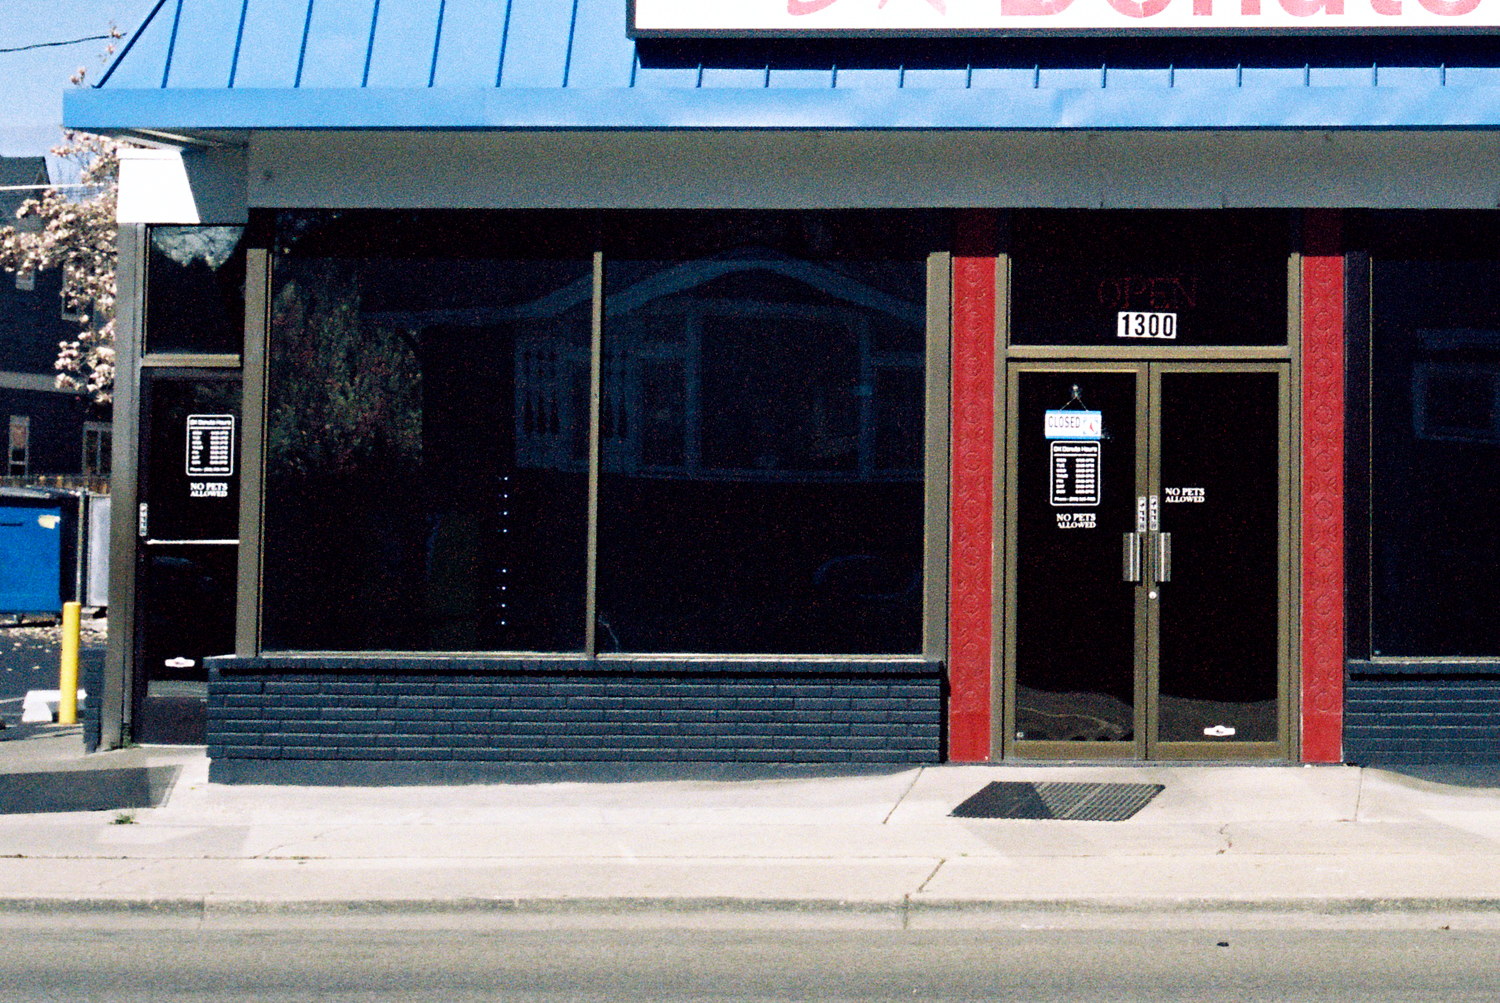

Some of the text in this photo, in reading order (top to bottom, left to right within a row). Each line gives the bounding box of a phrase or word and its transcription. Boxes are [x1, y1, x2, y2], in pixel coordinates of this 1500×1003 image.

[1099, 277, 1197, 308] OPEN
[1122, 314, 1174, 336] 1300
[1048, 416, 1081, 428] CLOSED
[190, 482, 229, 491] NO PETS
[190, 490, 228, 498] ALLOWED
[1165, 487, 1206, 496] NO PETS
[1056, 513, 1097, 522] NO PETS
[1057, 521, 1097, 529] ALLOWED
